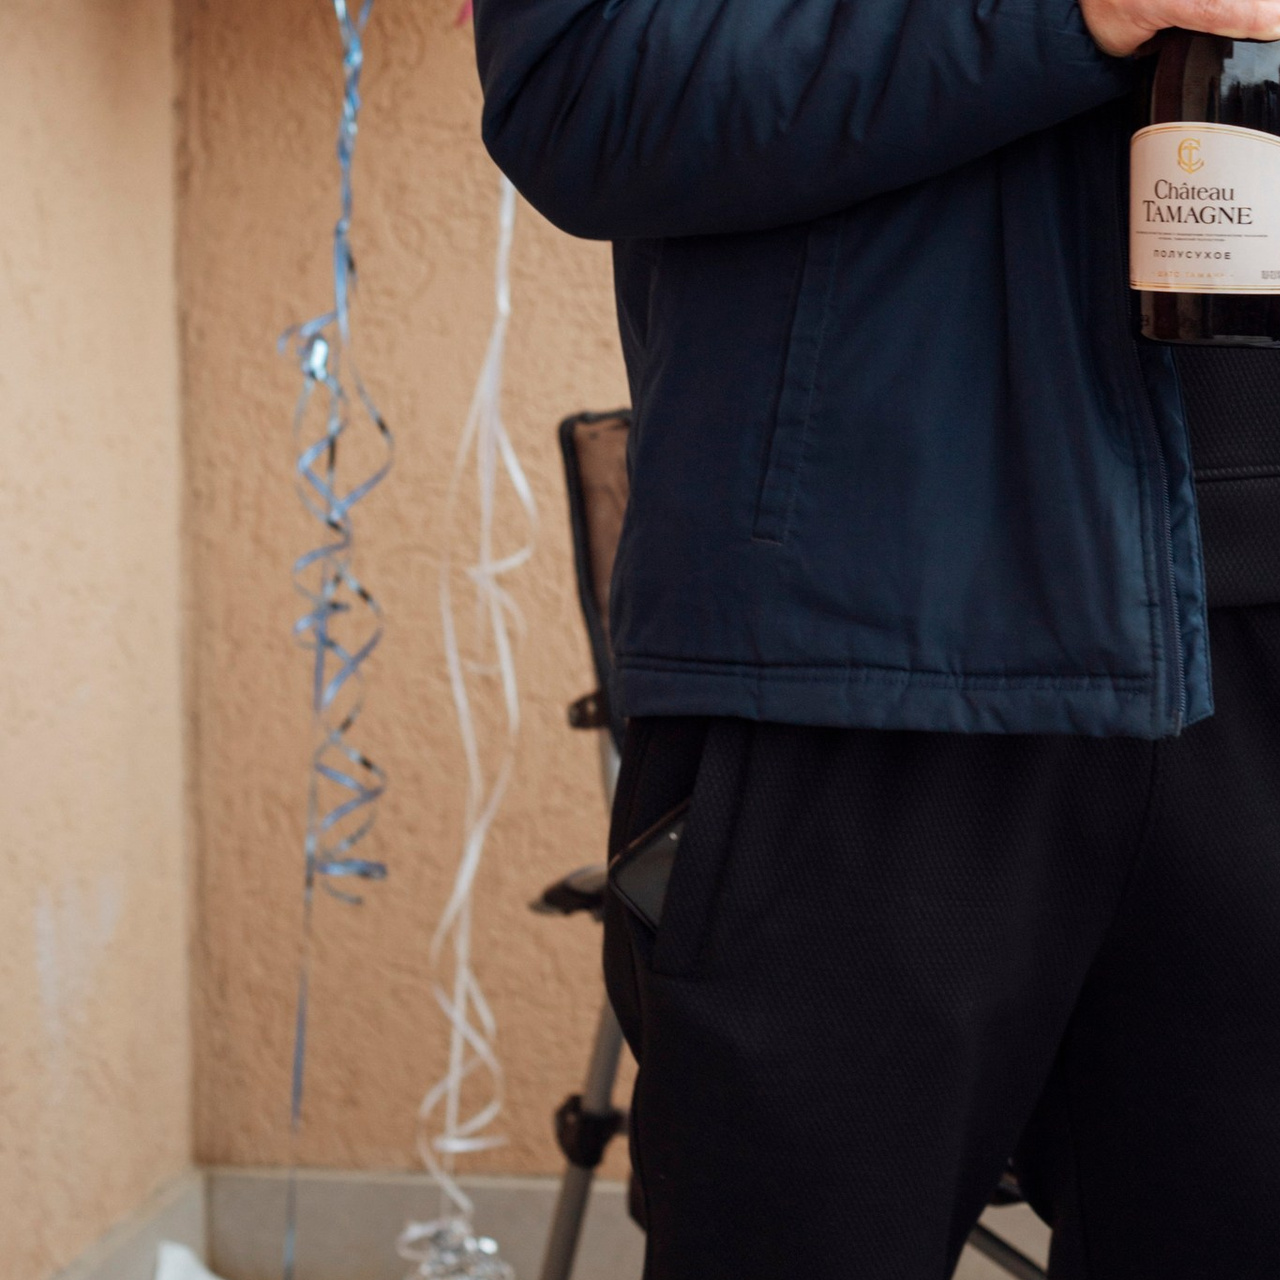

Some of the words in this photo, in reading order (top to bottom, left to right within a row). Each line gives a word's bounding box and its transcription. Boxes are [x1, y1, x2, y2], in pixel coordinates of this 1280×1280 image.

[1154, 179, 1234, 201] Château
[1142, 200, 1253, 225] TAMAGNE
[1153, 249, 1232, 260] ПОЛУСУХОЕ
